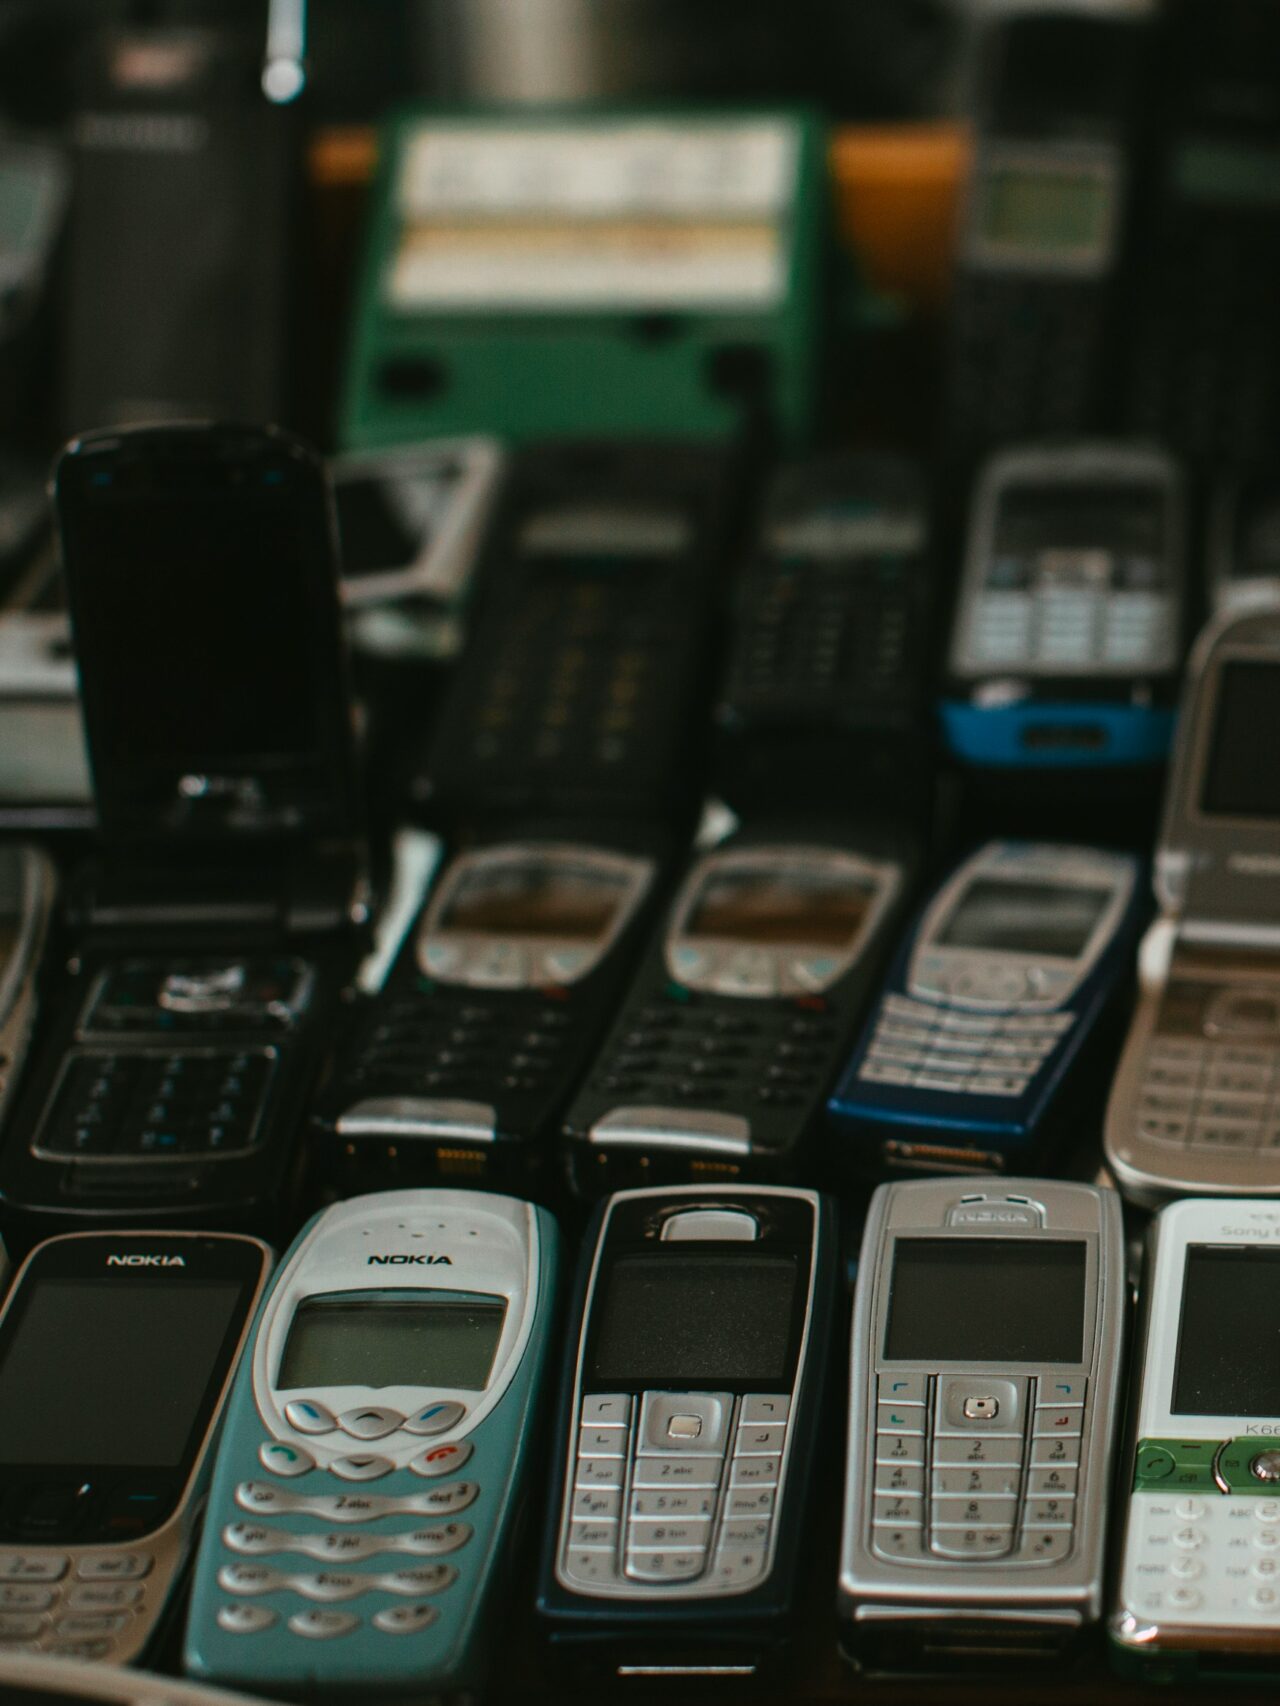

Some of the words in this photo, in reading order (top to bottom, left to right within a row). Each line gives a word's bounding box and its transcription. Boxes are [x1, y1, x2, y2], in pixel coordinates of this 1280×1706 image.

[1220, 1225, 1269, 1239] Sony
[106, 1255, 185, 1266] NOKIA
[367, 1255, 453, 1265] NOKIA
[896, 1438, 903, 1449] 1
[973, 1441, 982, 1452] 2
[1055, 1441, 1064, 1451] 3
[586, 1462, 593, 1473] 1
[661, 1465, 670, 1475] 2
[765, 1462, 774, 1472] 3
[971, 1470, 979, 1480] 5
[1049, 1471, 1059, 1482] 6
[759, 1493, 769, 1503] 6
[1263, 1502, 1278, 1514] 2
[1179, 1527, 1193, 1539] 4
